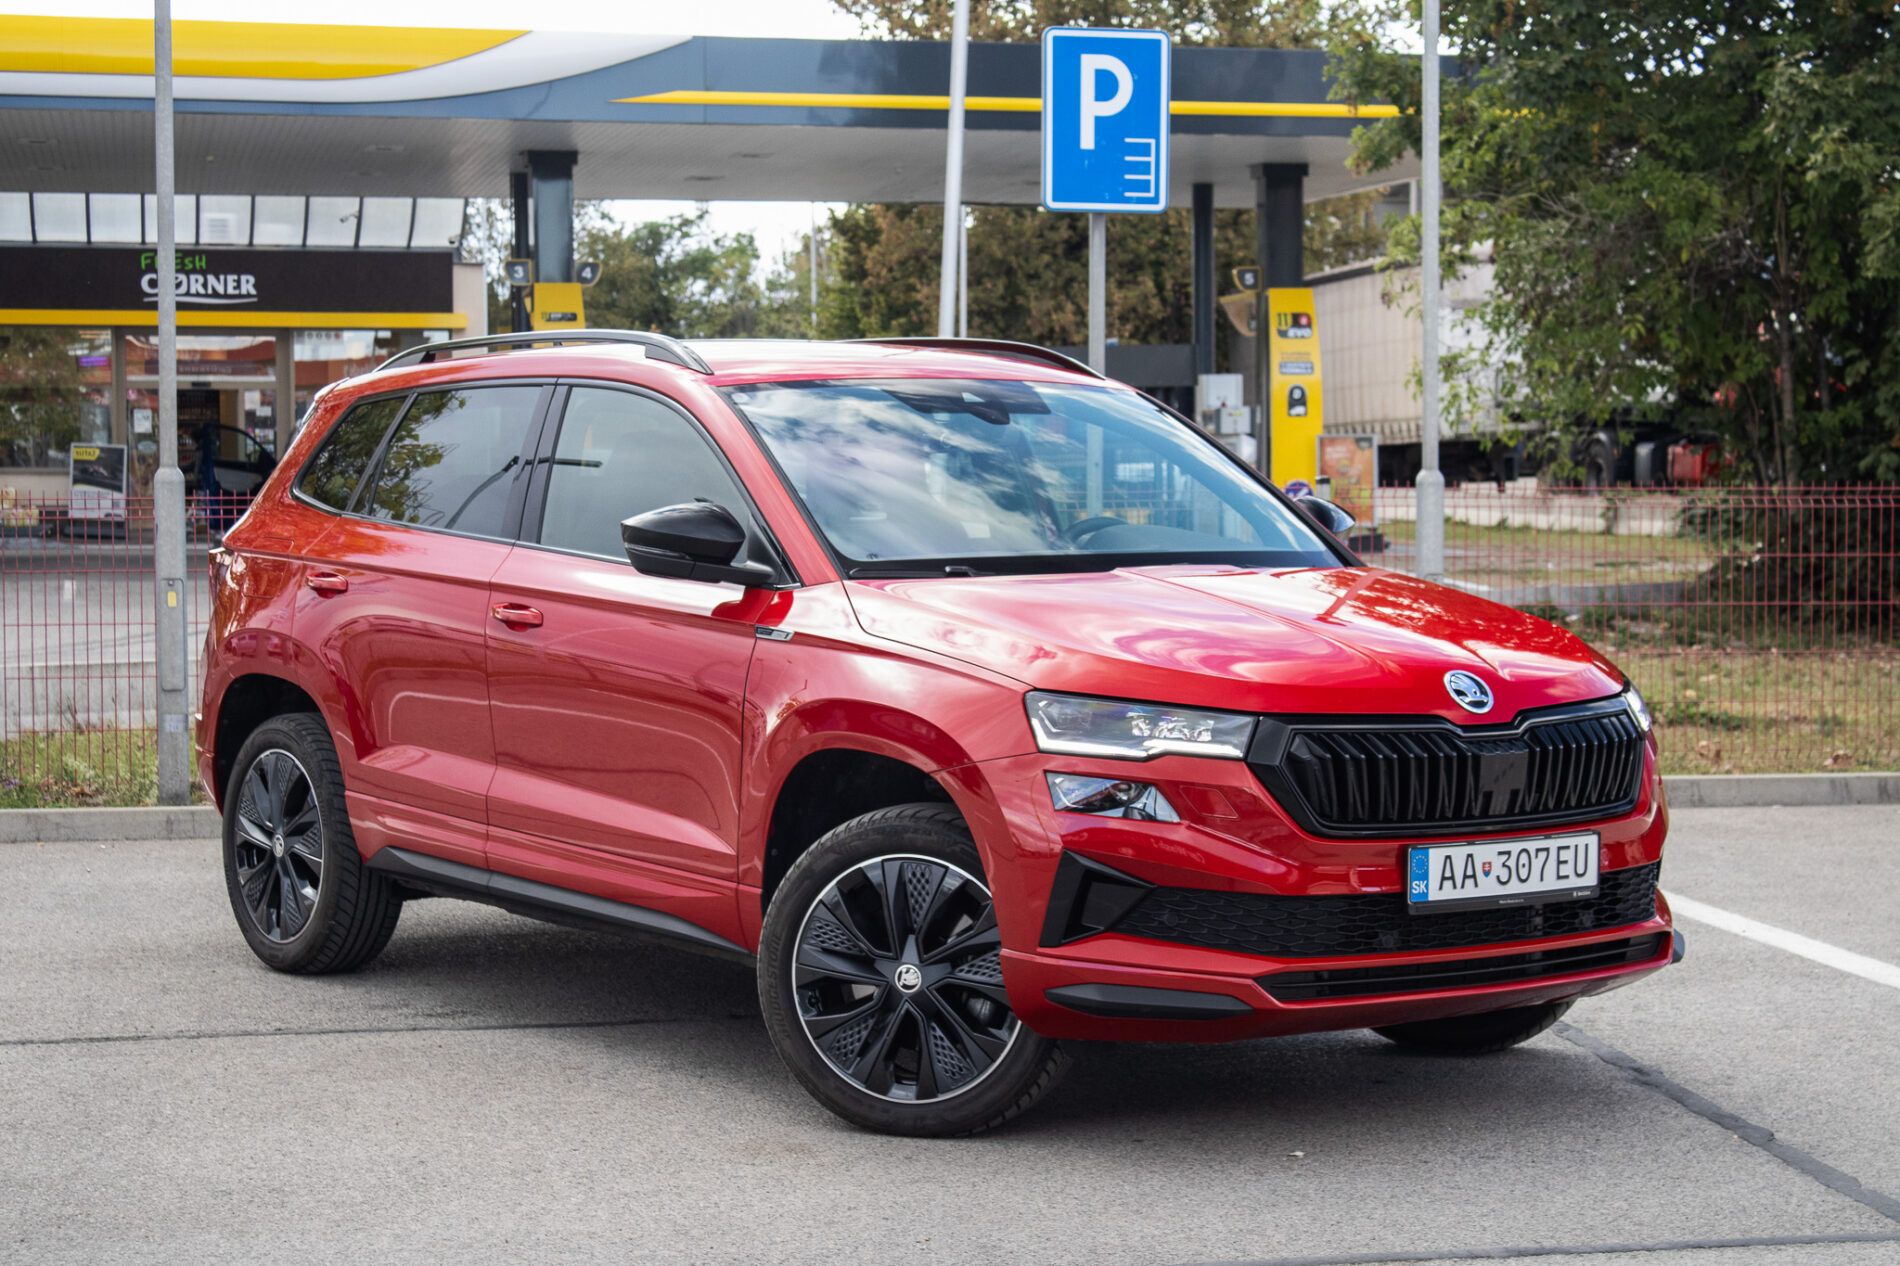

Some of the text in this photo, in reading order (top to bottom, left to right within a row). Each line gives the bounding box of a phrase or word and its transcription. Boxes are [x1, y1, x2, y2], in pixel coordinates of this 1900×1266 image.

[1080, 54, 1134, 150] P
[141, 252, 207, 270] FESH
[513, 265, 524, 279] 3
[581, 266, 593, 279] 4
[1438, 843, 1589, 891] AA 307EU
[1411, 880, 1428, 894] SK
